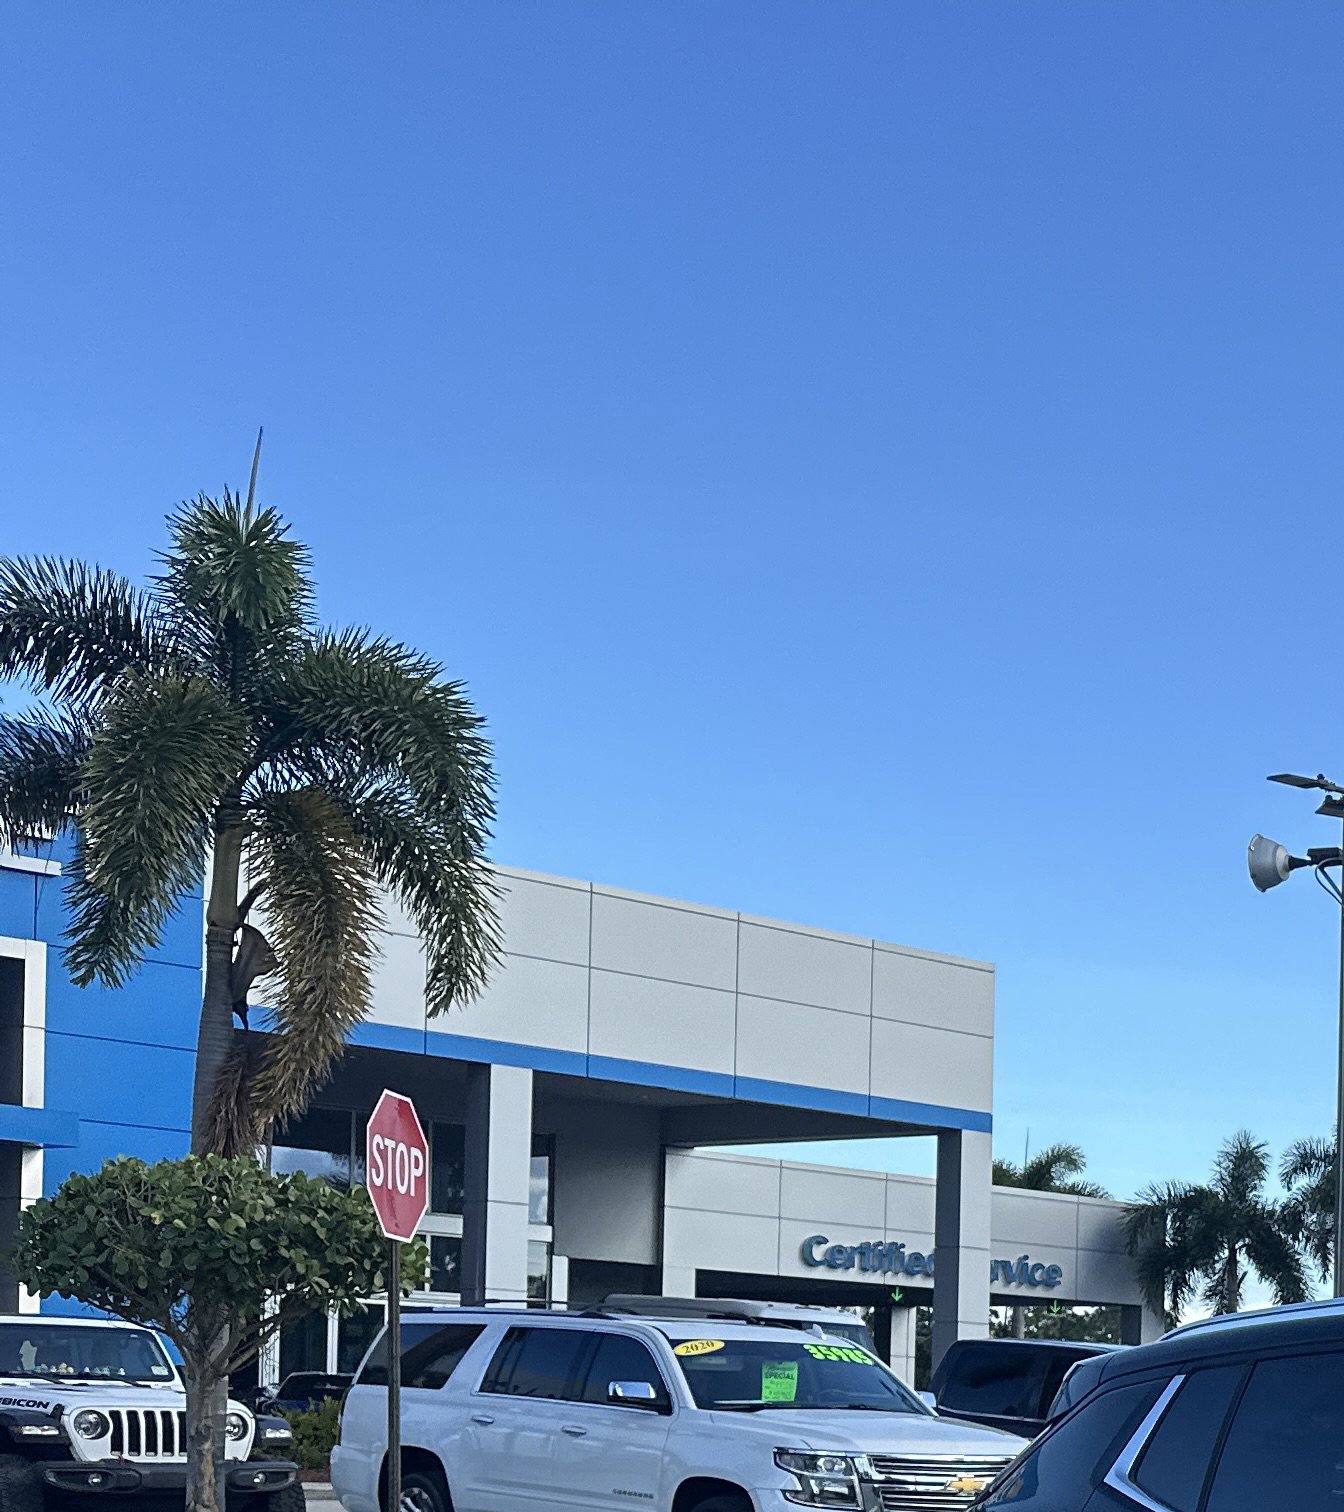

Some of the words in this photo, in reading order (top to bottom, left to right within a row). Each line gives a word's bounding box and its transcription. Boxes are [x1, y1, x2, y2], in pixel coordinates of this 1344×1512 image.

[371, 1134, 424, 1197] STOP
[990, 1255, 1063, 1287] rvice
[681, 1340, 715, 1354] 2020
[0, 1397, 50, 1410] BICON
